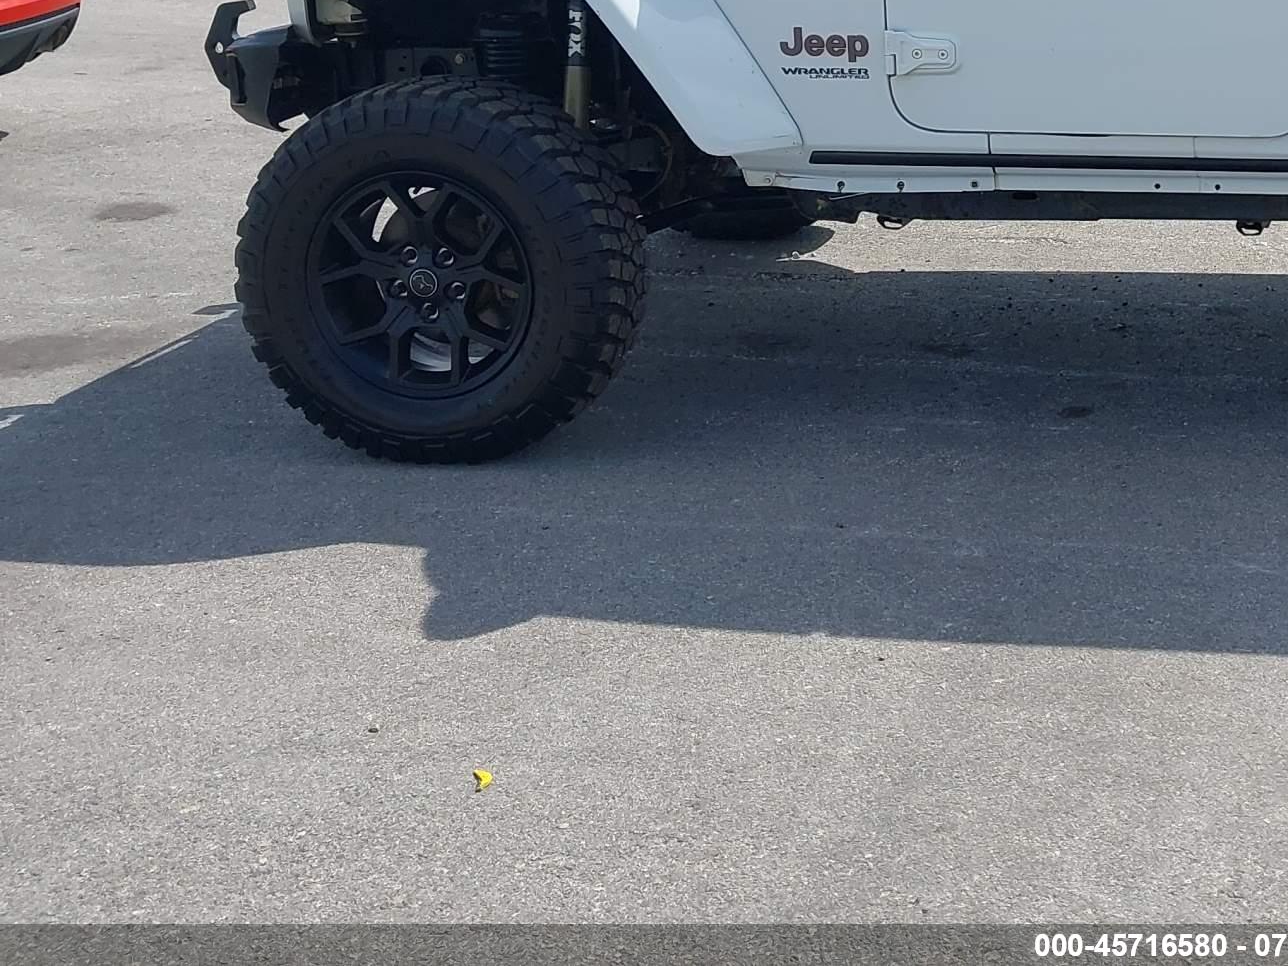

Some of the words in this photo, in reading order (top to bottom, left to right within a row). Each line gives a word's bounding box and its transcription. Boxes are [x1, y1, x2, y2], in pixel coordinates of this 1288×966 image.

[565, 9, 584, 57] FOX
[779, 26, 870, 63] Jeep
[779, 66, 869, 75] WRANGLER
